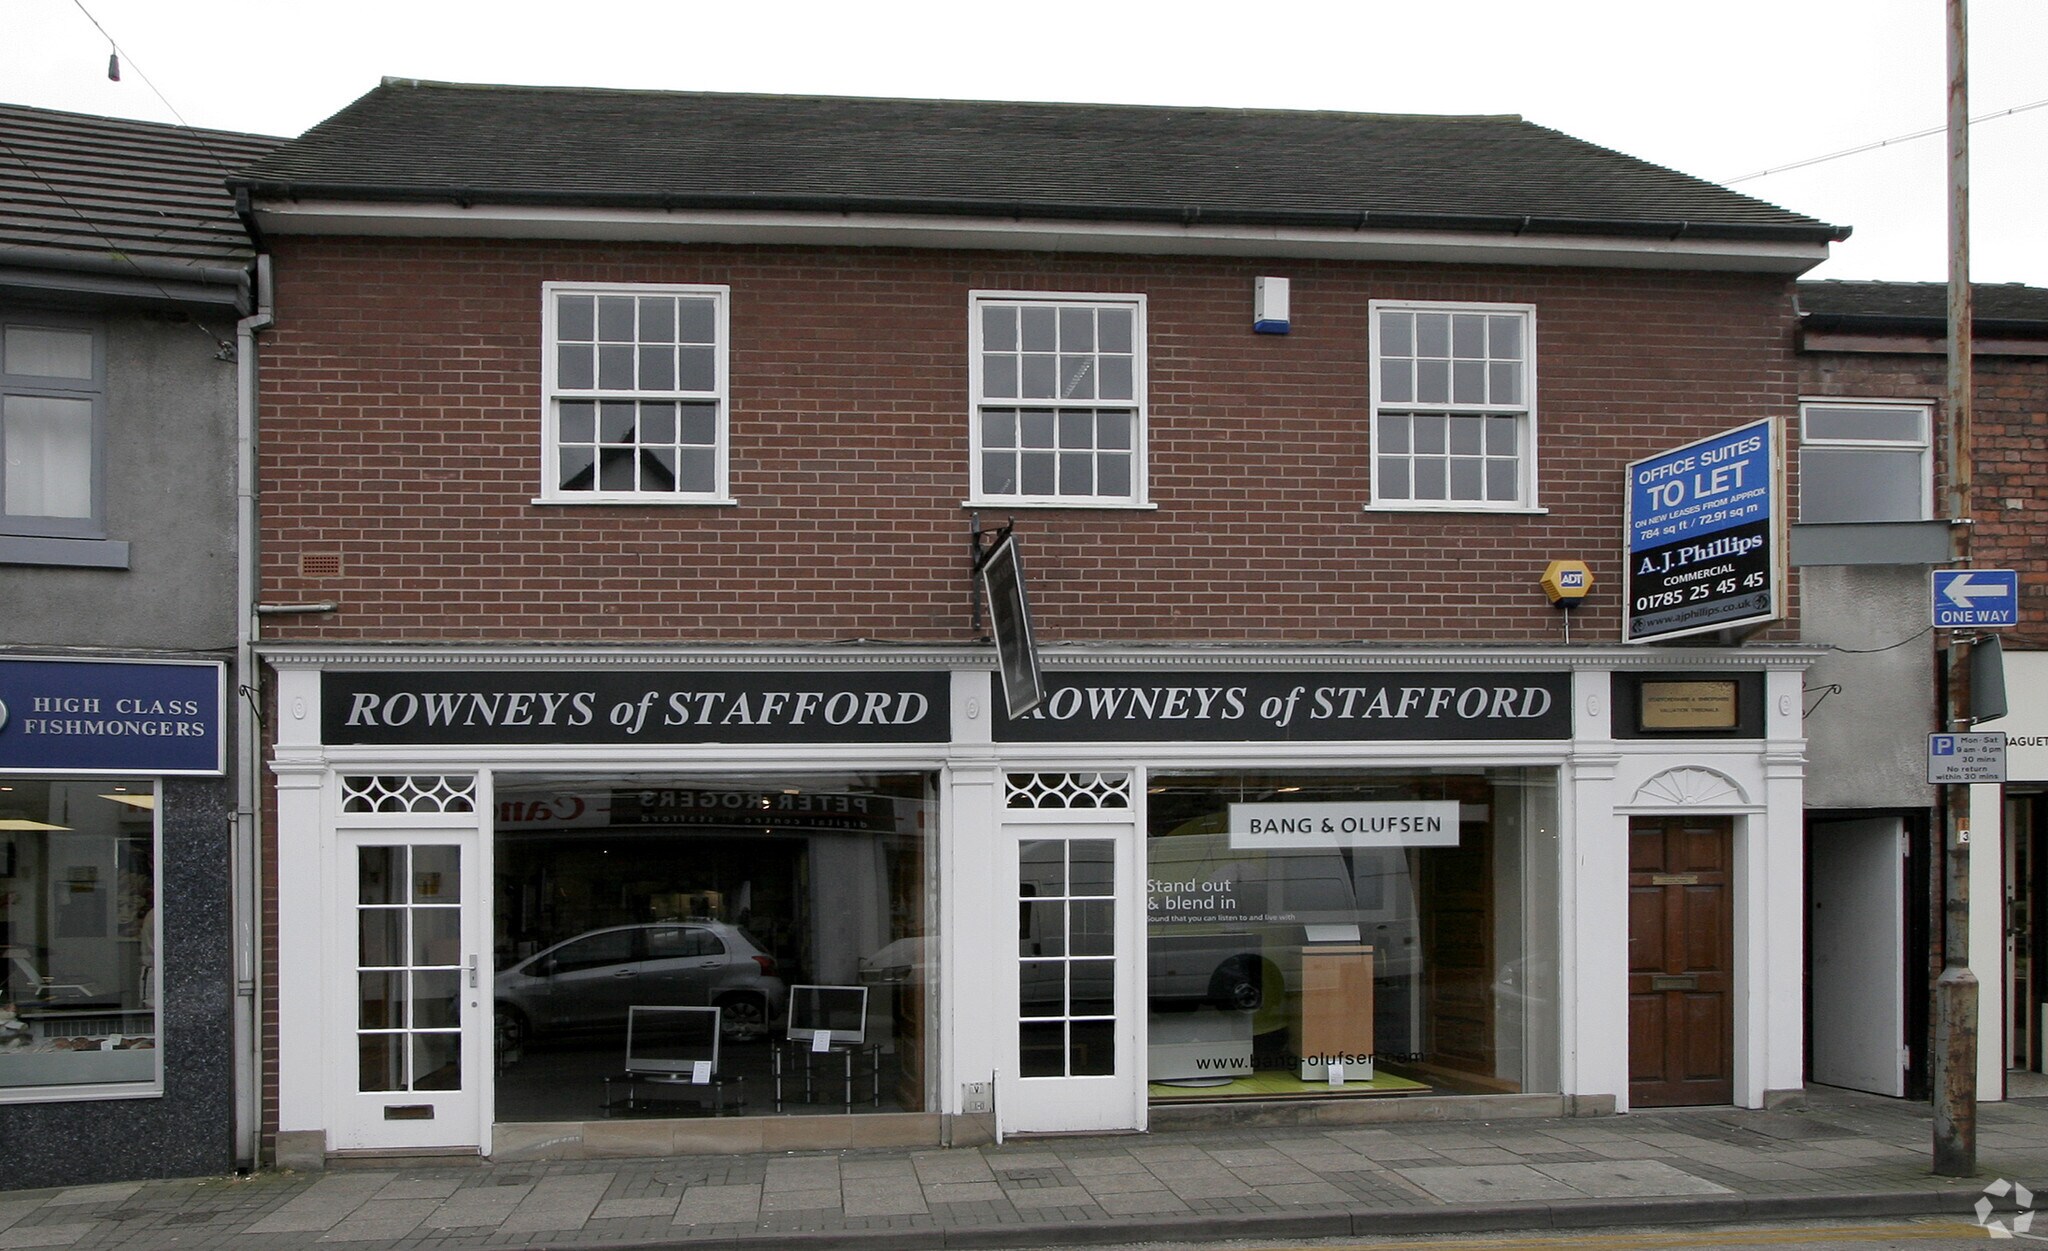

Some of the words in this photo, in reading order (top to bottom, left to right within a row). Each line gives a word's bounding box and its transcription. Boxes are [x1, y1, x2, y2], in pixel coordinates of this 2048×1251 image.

[1638, 456, 1696, 485] OFFICE
[1700, 435, 1762, 467] SUITES
[1647, 479, 1685, 511] TO
[1694, 459, 1750, 500] LET
[1635, 519, 1647, 529] ON
[1648, 513, 1667, 526] NEW
[1669, 504, 1701, 521] LEASES
[1702, 497, 1728, 511] FROM
[1730, 487, 1766, 504] APPROX
[1640, 529, 1660, 541] 784
[1663, 524, 1677, 535] sq
[1679, 520, 1688, 531] ft
[1699, 511, 1727, 526] 72.91
[1729, 508, 1744, 519] sq
[1746, 503, 1758, 513] m
[1561, 573, 1583, 584] ADT
[1663, 563, 1735, 587] COMMERCIAL
[1636, 589, 1683, 612] 01785
[1689, 586, 1710, 601] 25
[1716, 578, 1736, 594] 45
[1743, 571, 1764, 588] 45
[1646, 598, 1751, 627] www.ajphillips.co.uk
[1941, 610, 1973, 623] ONE
[1977, 610, 2009, 623] WAY
[33, 697, 100, 713] HIGH
[116, 699, 198, 716] CLASS
[344, 692, 596, 727] ROWNEYS
[609, 691, 660, 734] of
[664, 692, 929, 727] STAFFORD
[1260, 687, 1306, 728] of
[1310, 687, 1552, 720] STAFFORD
[24, 719, 205, 737] FISHMONGERS
[1249, 817, 1313, 835] BANG
[1321, 817, 1336, 833] &
[1340, 816, 1442, 834] OLUFSEN
[1147, 878, 1195, 893] Stand
[1201, 879, 1232, 893] out
[1147, 896, 1159, 910] &
[1165, 895, 1214, 910] blend
[1221, 895, 1236, 909] in
[1171, 914, 1187, 922] that
[1188, 916, 1202, 924] you
[1218, 914, 1238, 922] listen
[1278, 913, 1296, 921] with
[1196, 1051, 1425, 1070] www.bang-olufsencom
